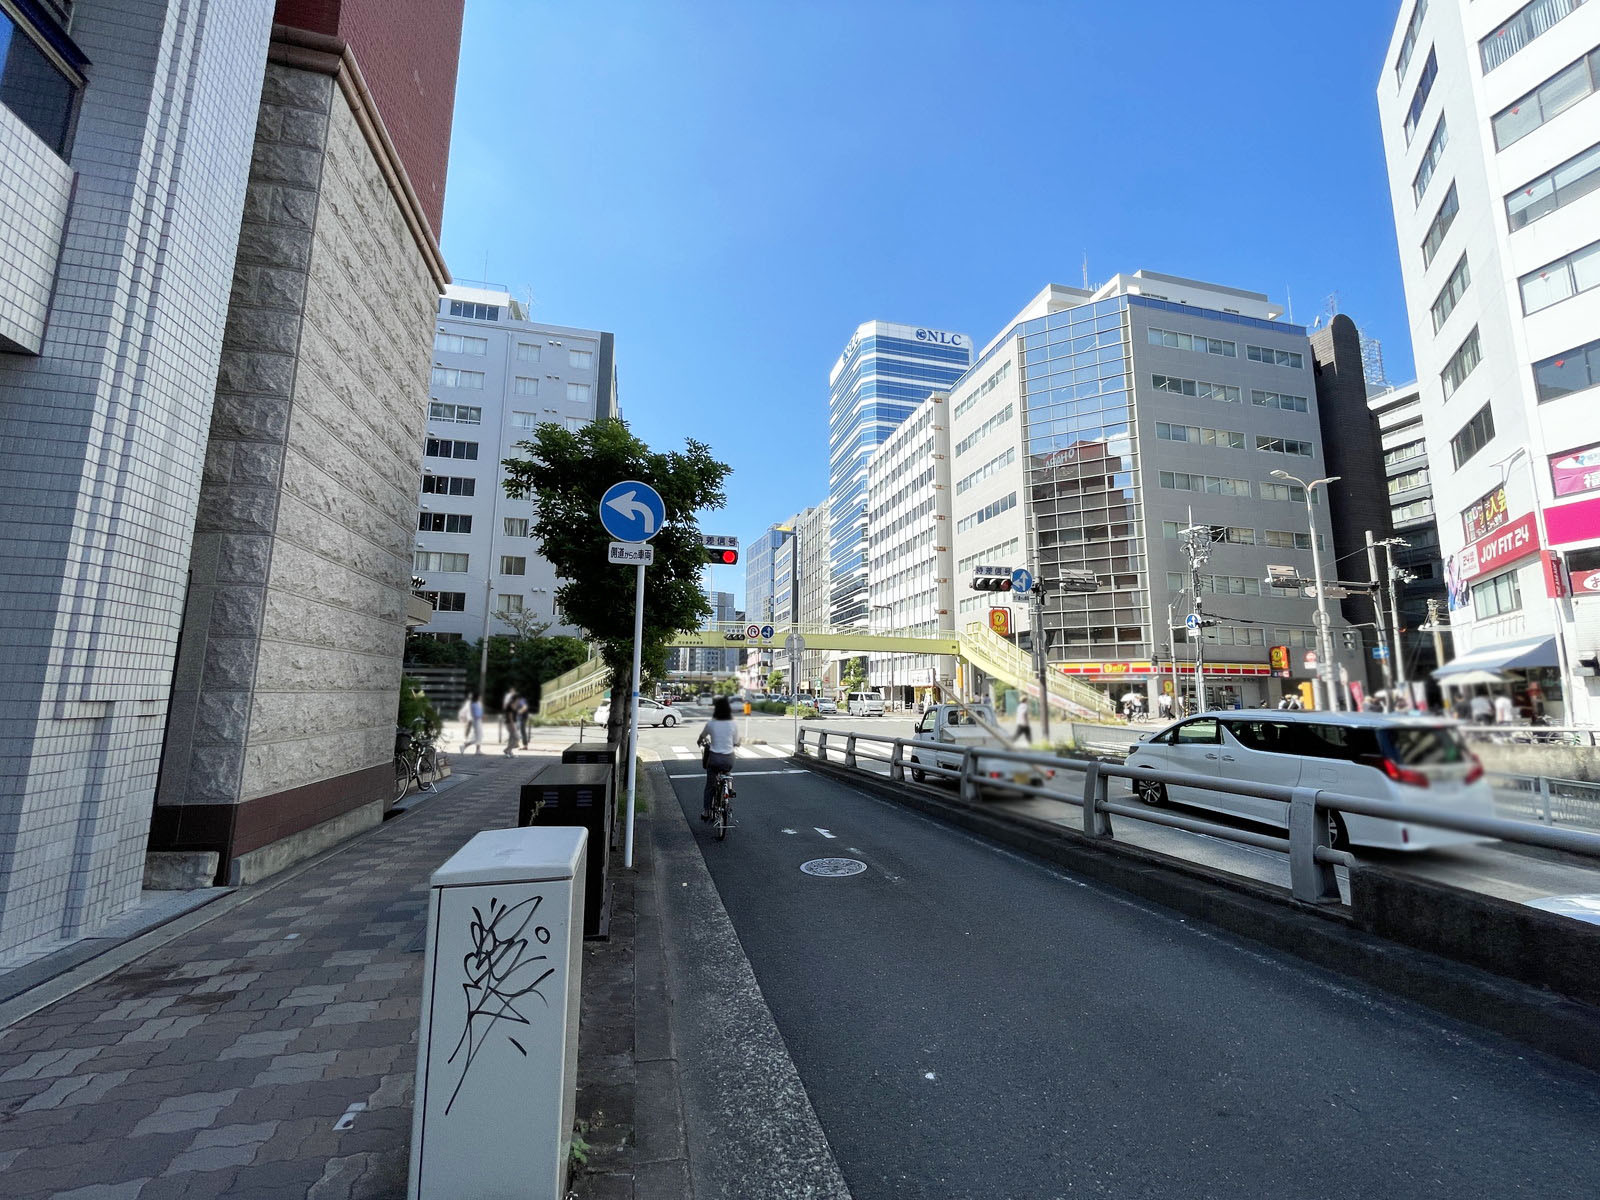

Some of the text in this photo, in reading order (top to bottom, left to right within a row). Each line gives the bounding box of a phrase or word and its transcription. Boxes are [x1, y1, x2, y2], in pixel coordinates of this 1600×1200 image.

[927, 330, 962, 346] NLC
[610, 547, 652, 561] 側道からの車両
[975, 566, 1011, 576] 時差信号
[1103, 663, 1127, 673] Daily
